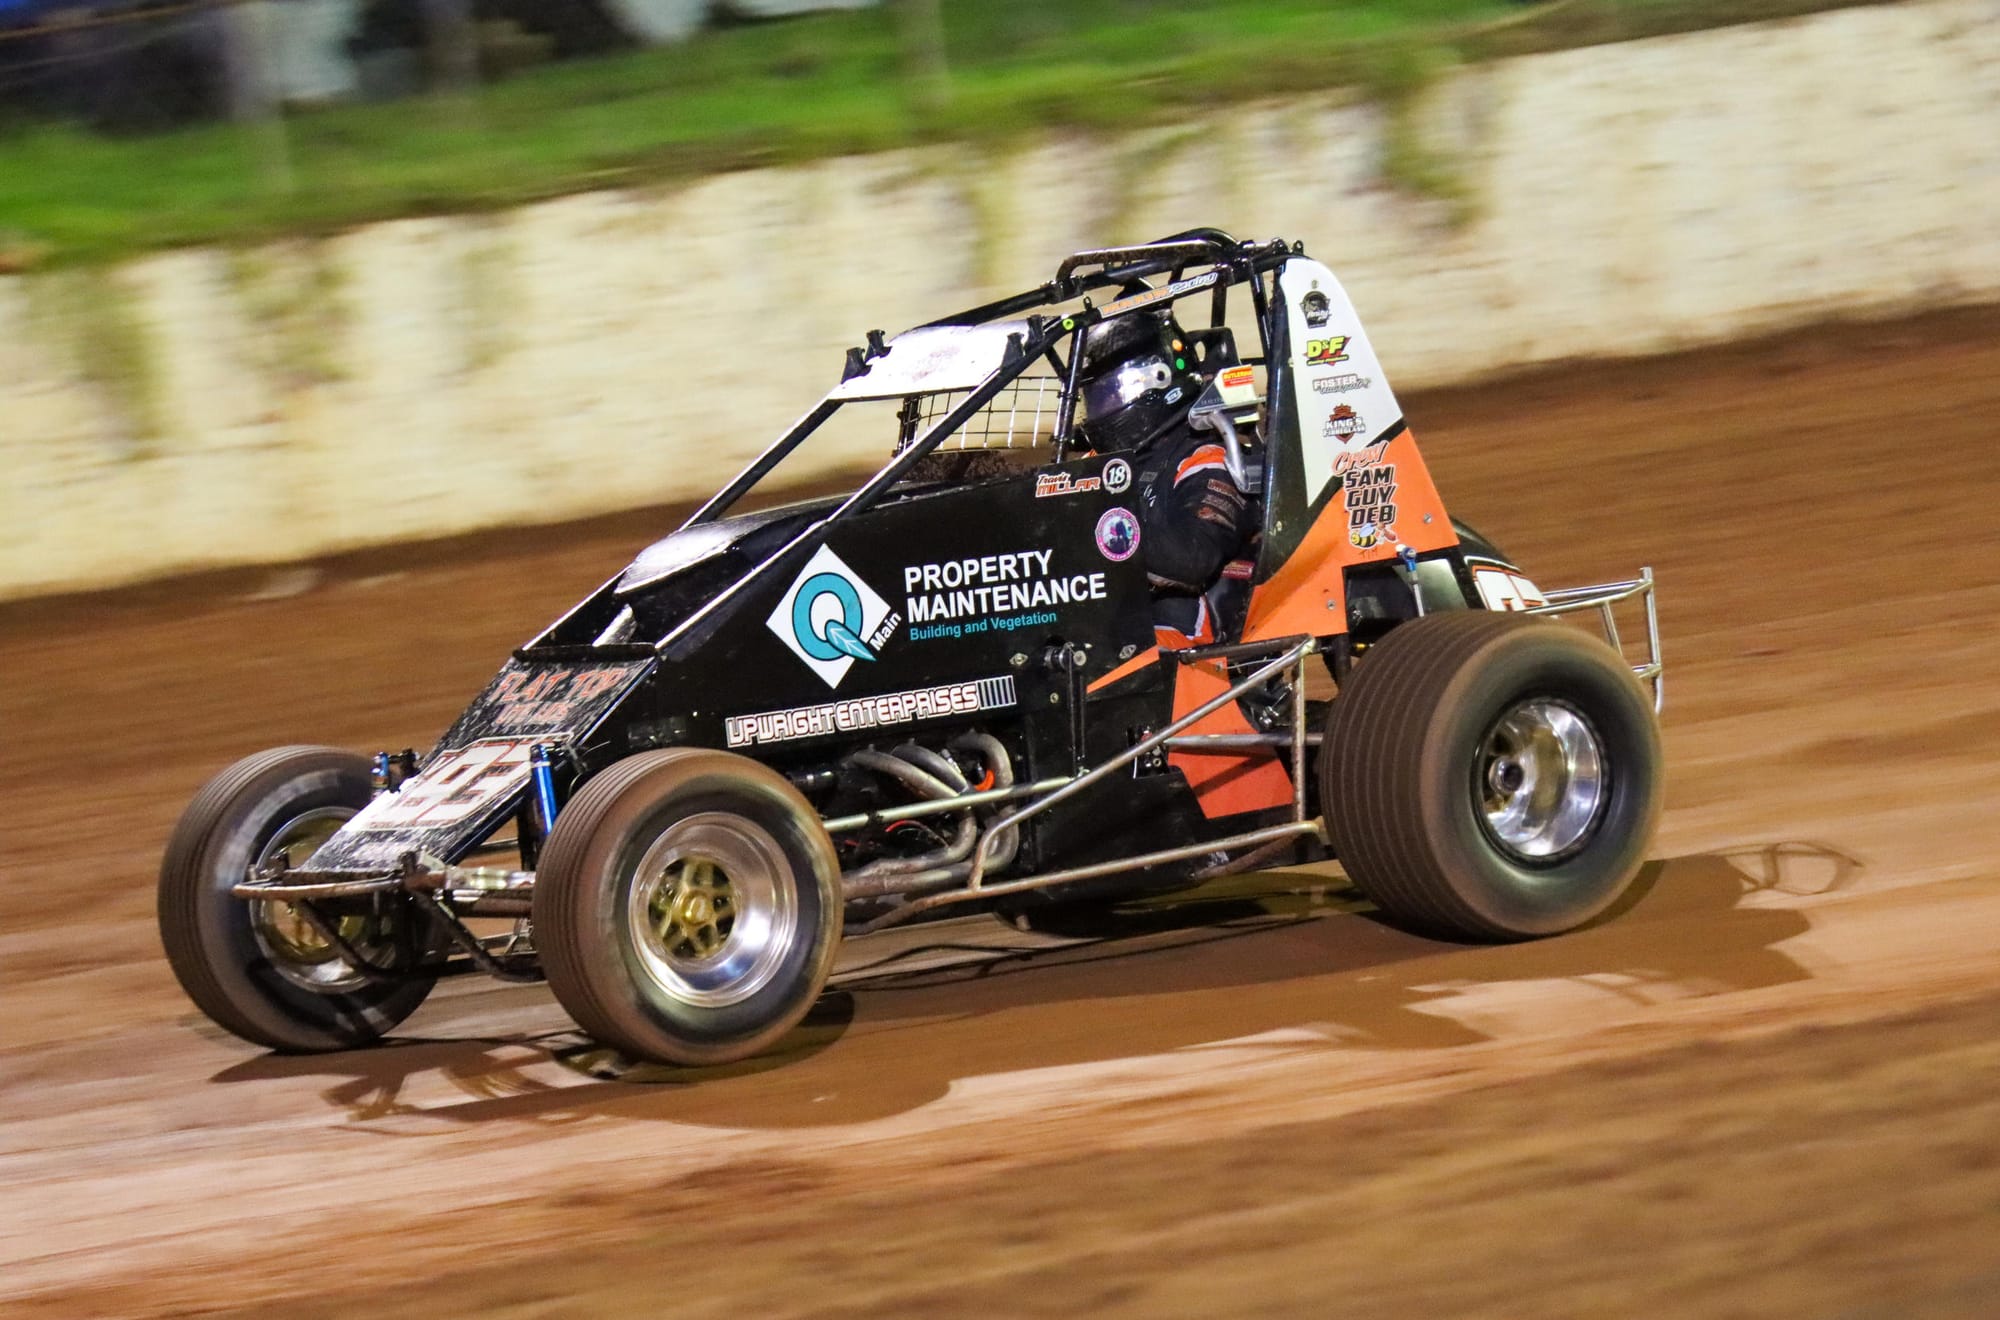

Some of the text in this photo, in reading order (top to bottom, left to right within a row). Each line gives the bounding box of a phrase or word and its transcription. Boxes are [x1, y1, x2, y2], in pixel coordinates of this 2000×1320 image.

[1307, 336, 1345, 357] D&F
[1313, 374, 1358, 390] FOSTER
[1108, 465, 1126, 485] 18
[1345, 466, 1394, 489] SAM
[1036, 477, 1101, 497] MILLAR
[1347, 486, 1395, 508] GUY
[1351, 505, 1396, 529] DEB
[905, 550, 1052, 592] PROPERTY
[907, 573, 1106, 623] MAINTENANCE
[868, 611, 902, 651] Main
[909, 611, 1057, 640] Building and Vegetation
[727, 682, 980, 748] UPWRIGHT ENTERPRISES
